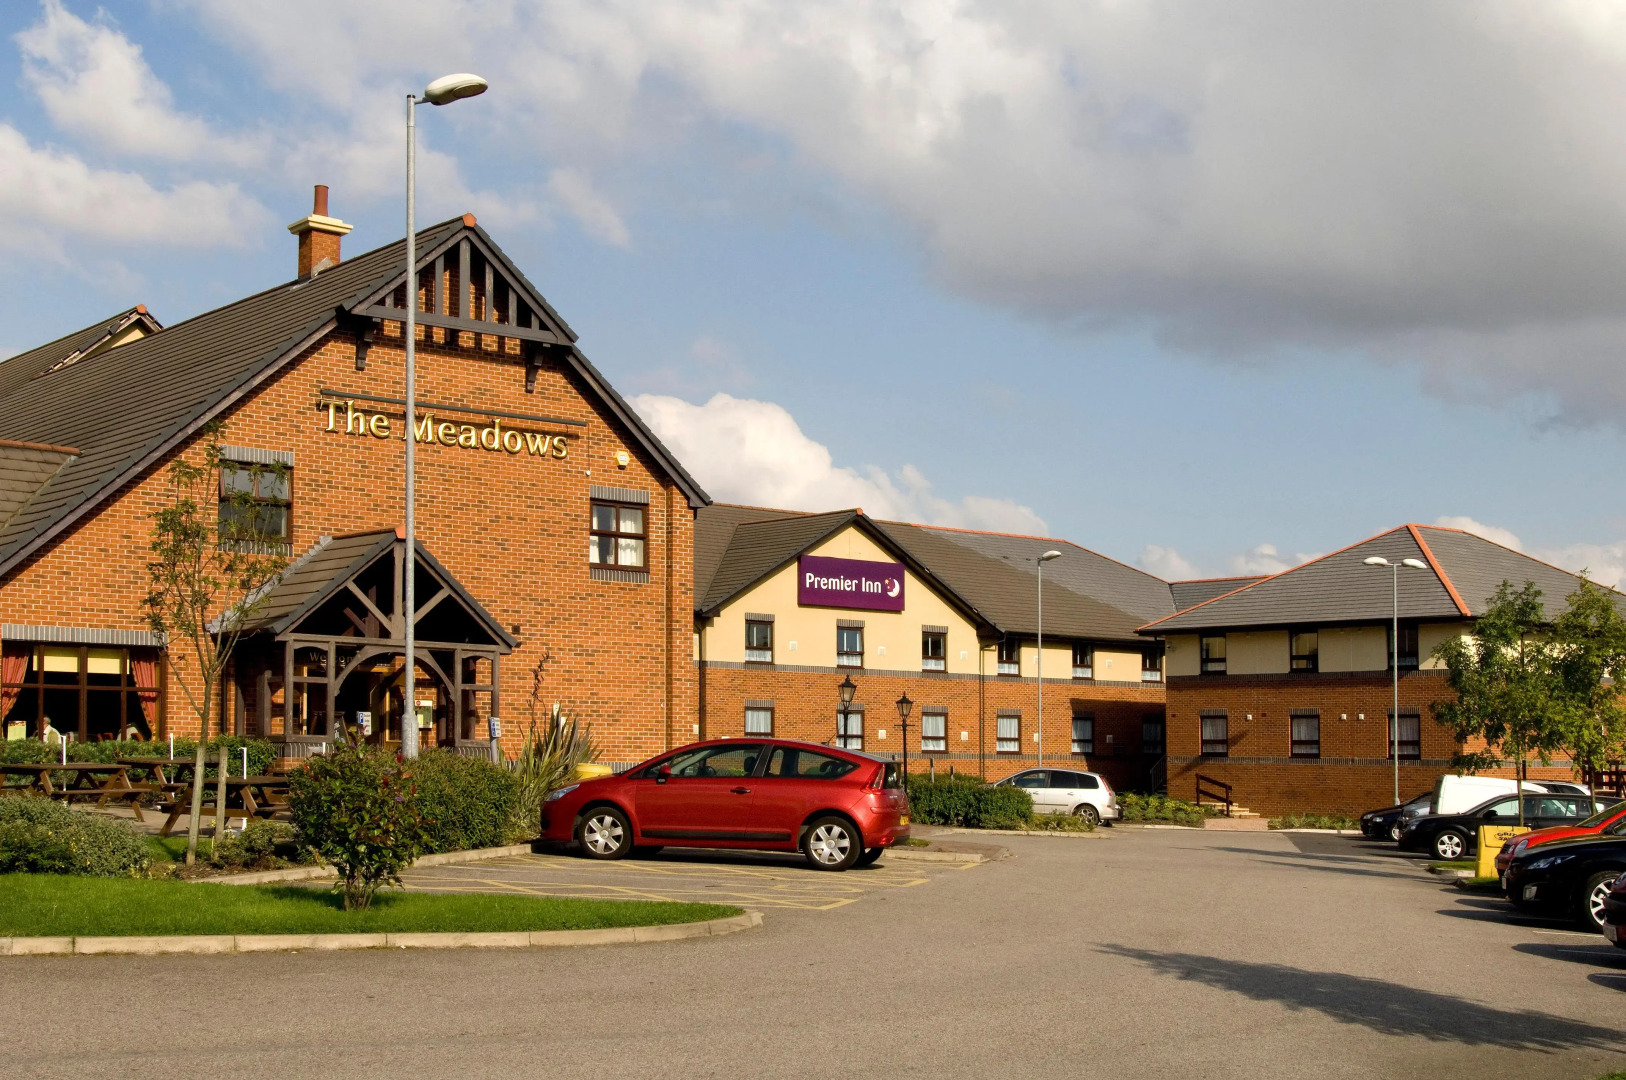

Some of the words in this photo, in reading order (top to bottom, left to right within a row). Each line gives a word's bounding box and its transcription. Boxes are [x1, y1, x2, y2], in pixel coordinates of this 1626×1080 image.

[320, 400, 390, 438] The
[403, 412, 568, 459] Meadows
[805, 572, 858, 592] Premier
[861, 577, 882, 593] Inn
